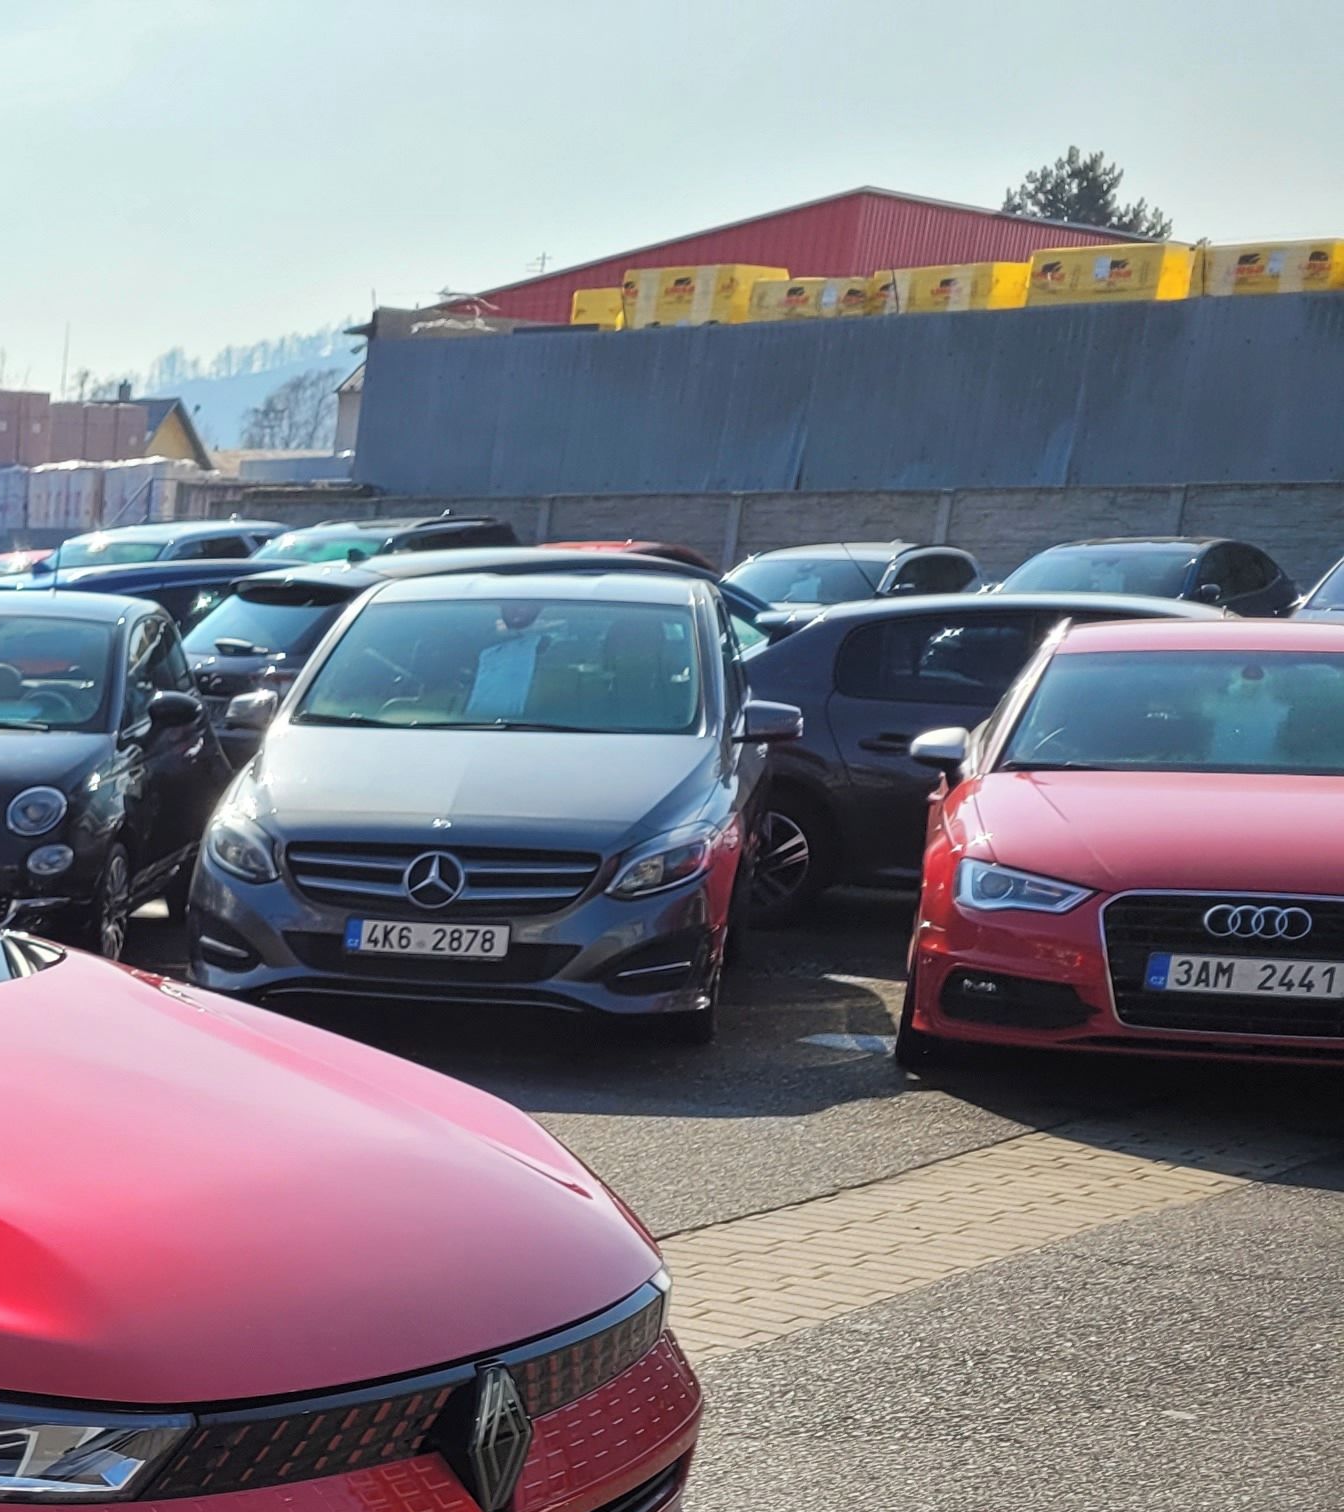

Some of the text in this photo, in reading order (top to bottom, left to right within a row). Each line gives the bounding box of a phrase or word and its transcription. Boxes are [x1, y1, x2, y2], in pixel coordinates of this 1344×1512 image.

[367, 923, 496, 953] 4K6 2878
[1150, 975, 1166, 985] CZ
[1175, 959, 1336, 994] 3AM 2441
